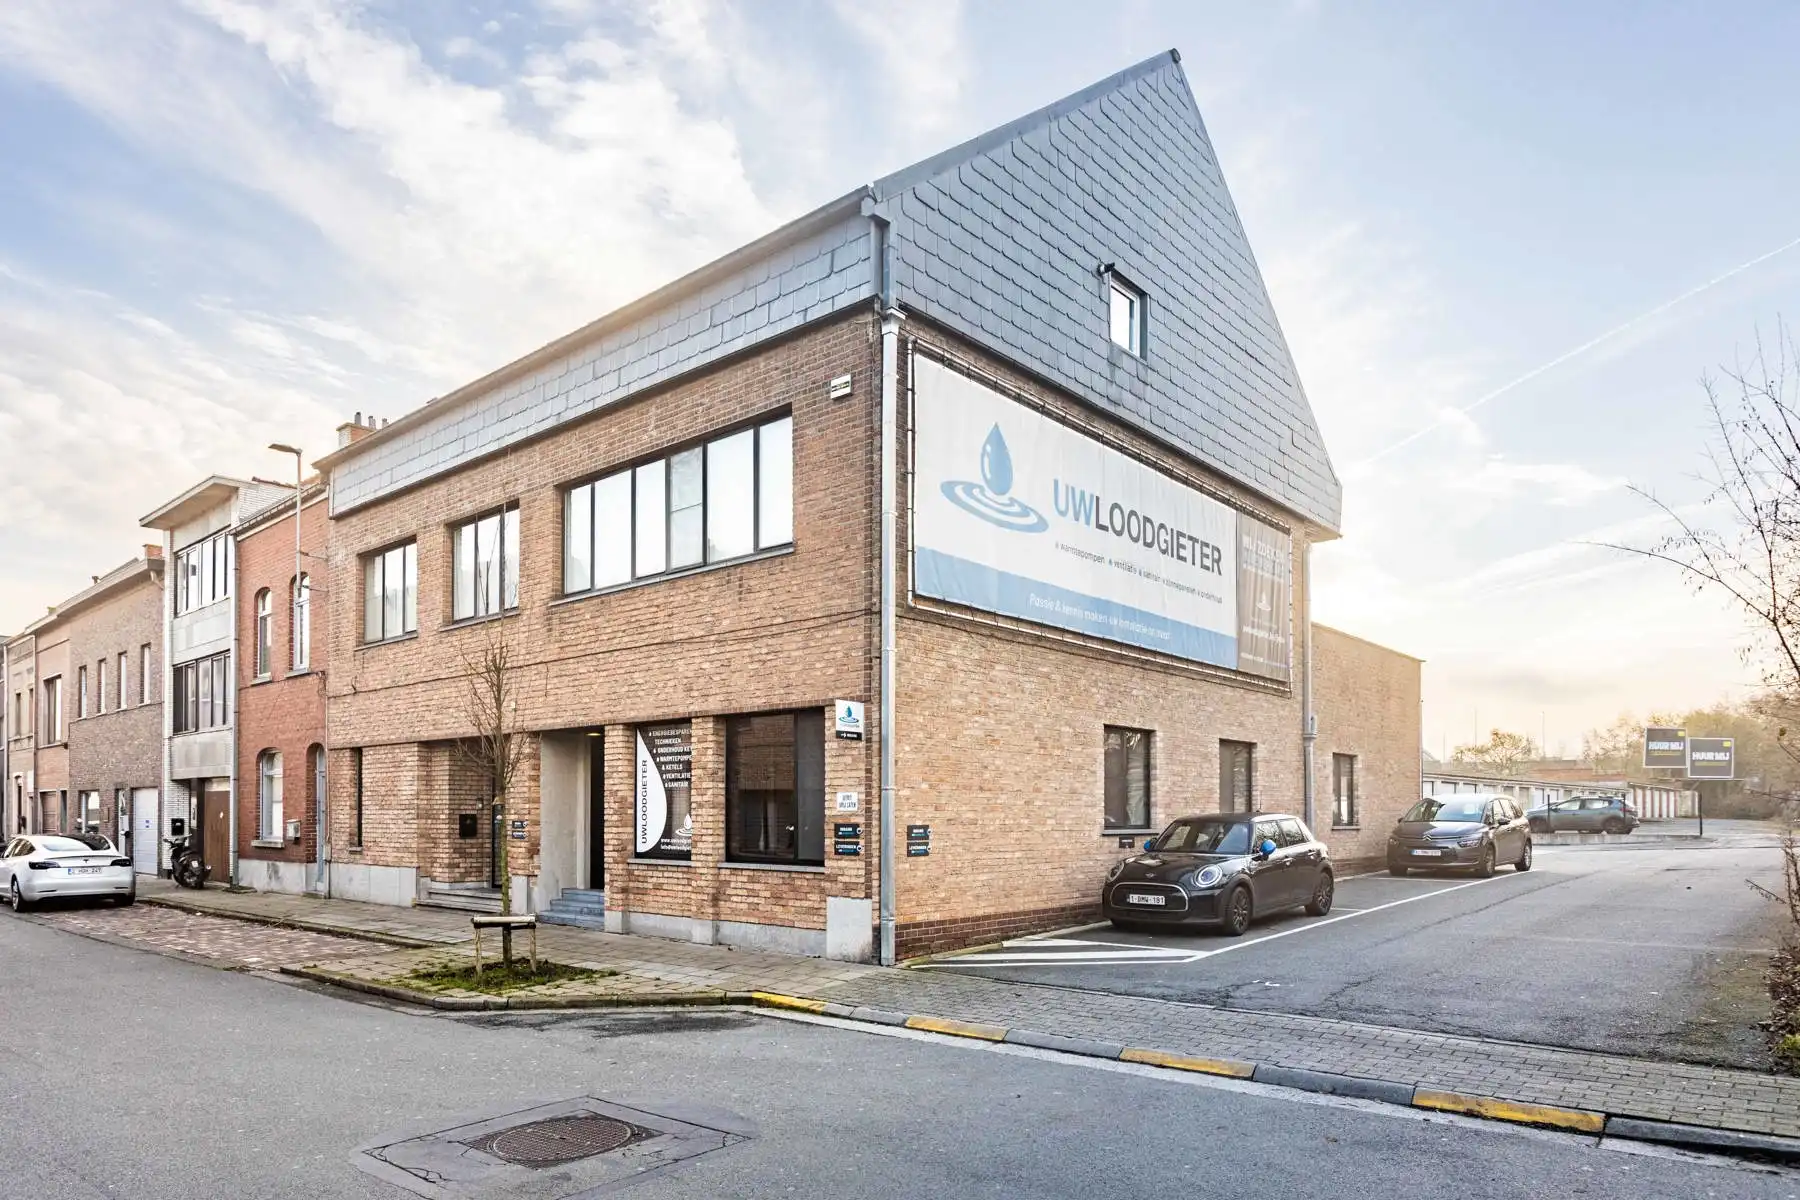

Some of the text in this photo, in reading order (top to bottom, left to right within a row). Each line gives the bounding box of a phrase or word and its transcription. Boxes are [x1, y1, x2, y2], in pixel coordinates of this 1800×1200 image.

[1053, 478, 1223, 576] UWLOODGIETER
[1029, 593, 1054, 612] Passie
[1692, 751, 1714, 761] HUUR
